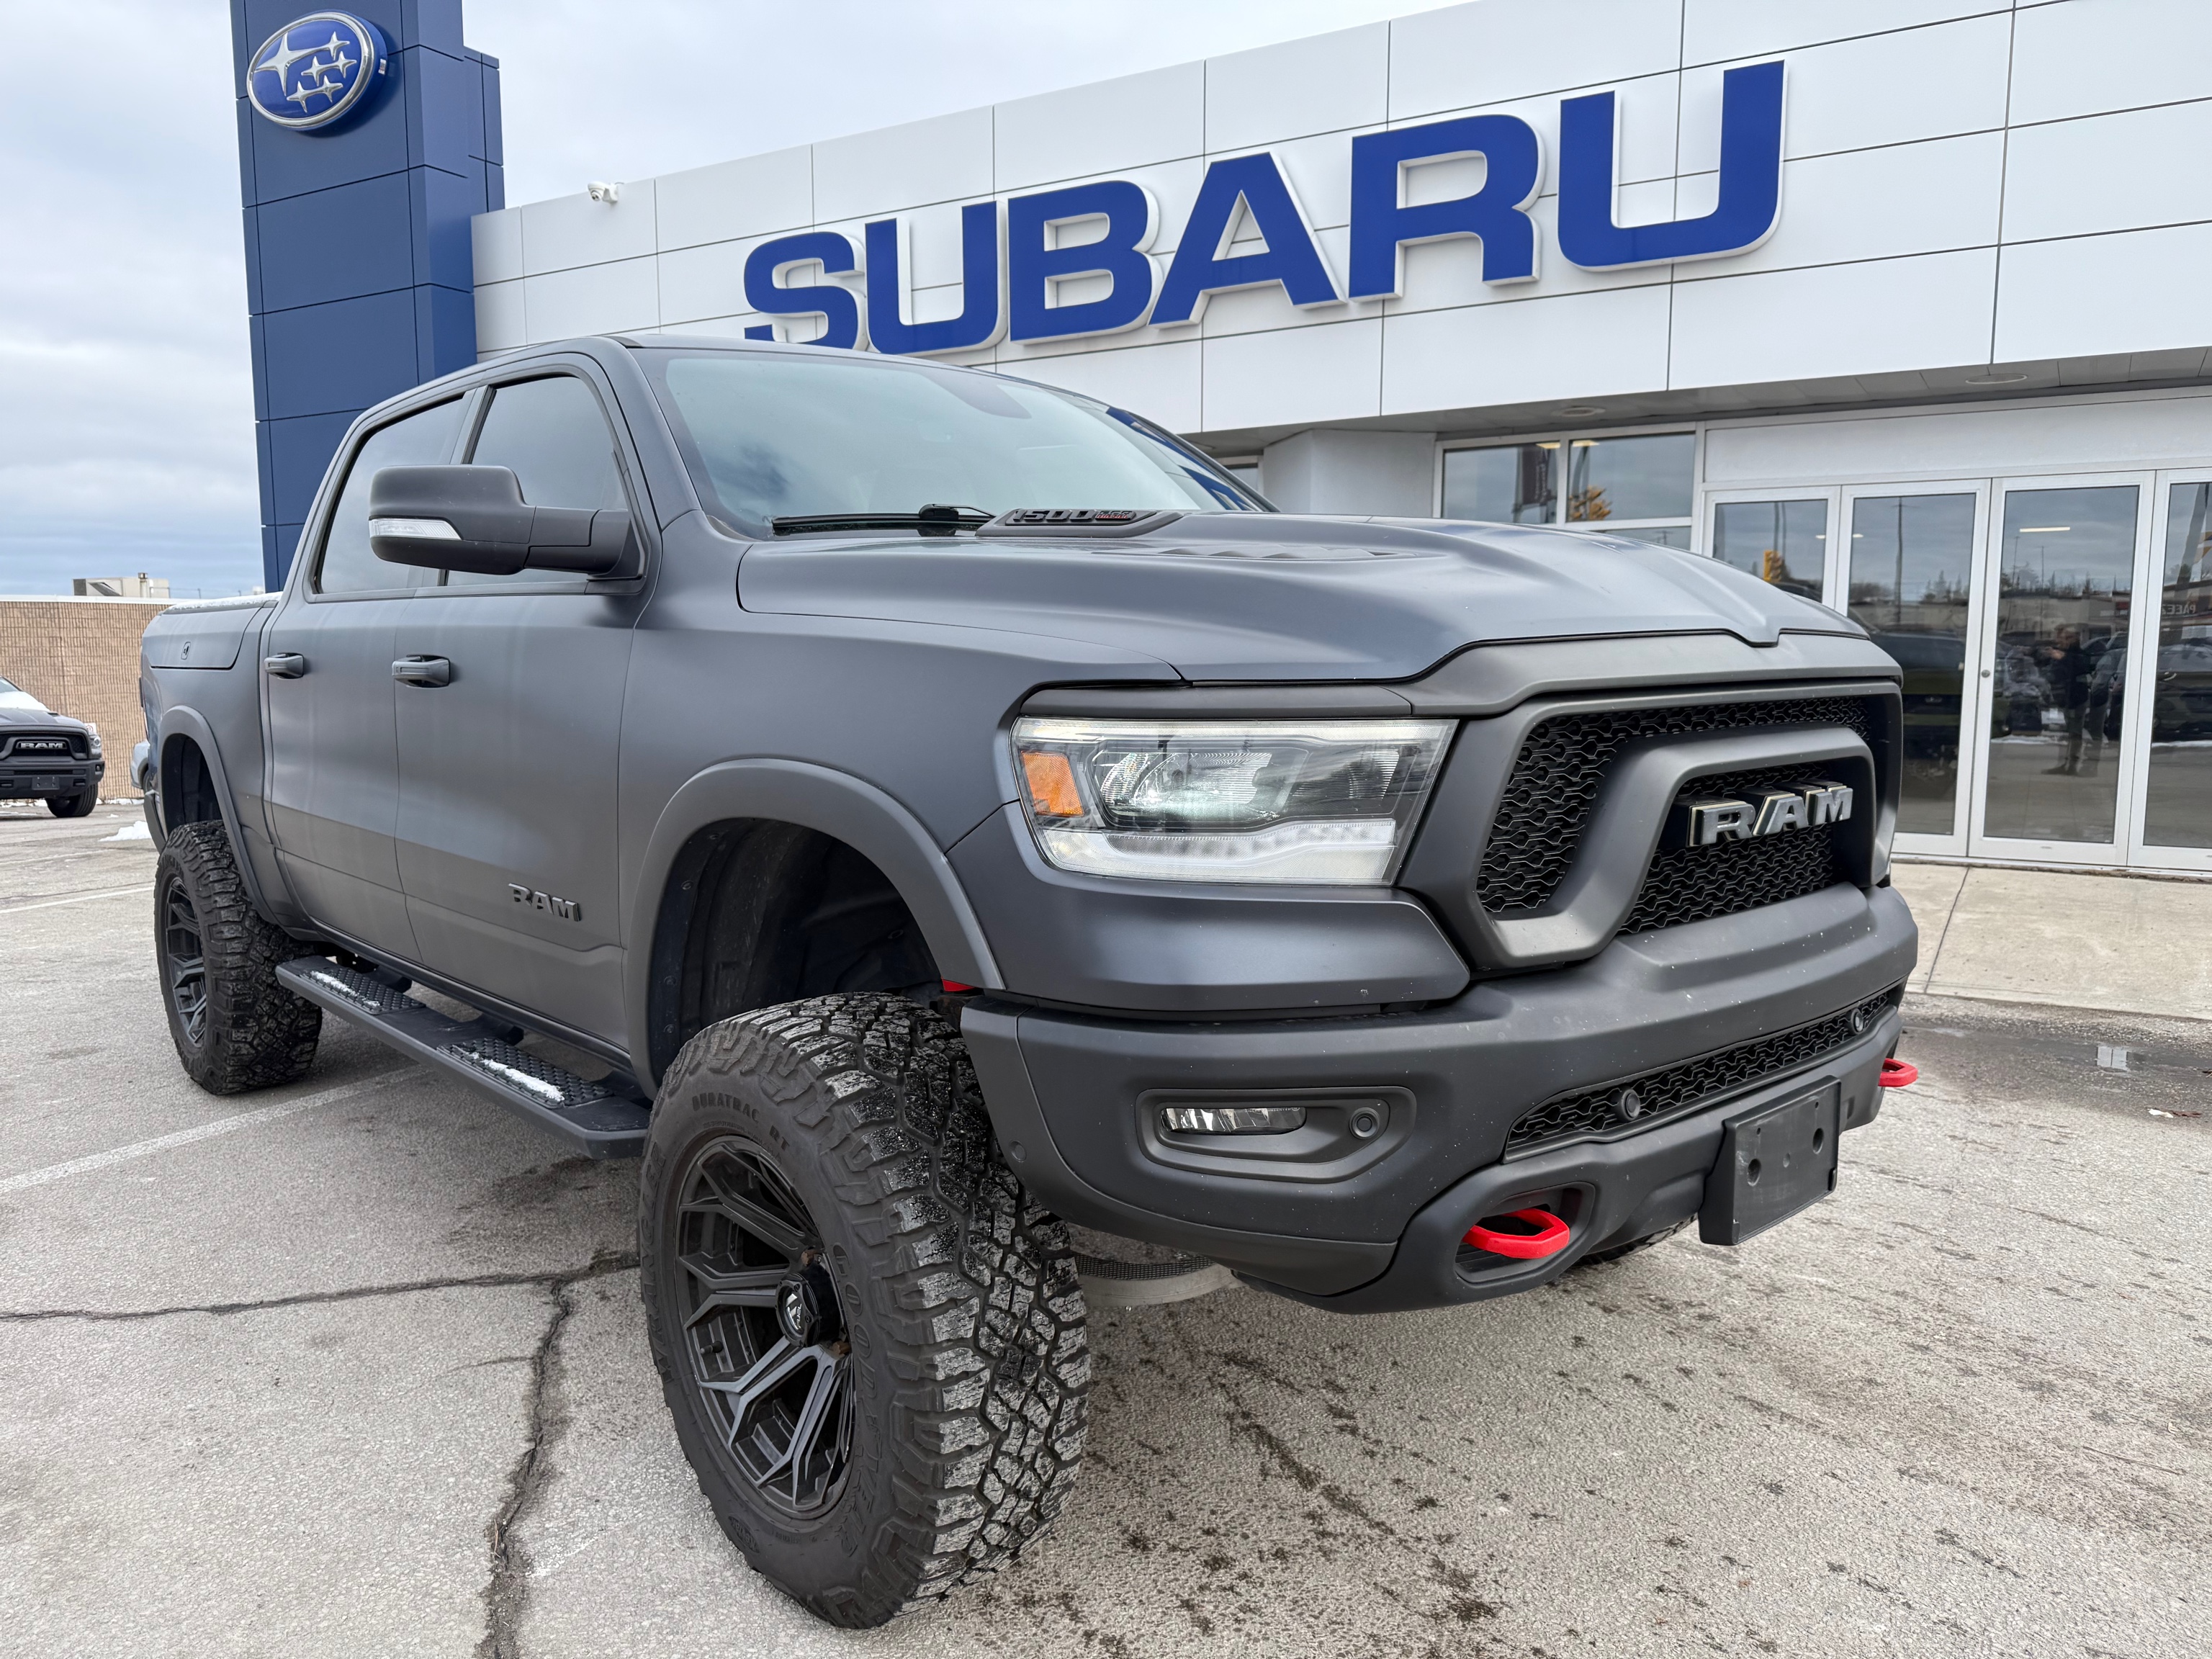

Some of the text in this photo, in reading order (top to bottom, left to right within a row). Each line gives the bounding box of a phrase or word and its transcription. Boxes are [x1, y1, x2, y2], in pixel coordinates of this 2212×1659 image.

[744, 60, 1786, 355] SUBARU
[1012, 509, 1096, 522] 1500
[1689, 786, 1853, 847] RAM
[508, 883, 581, 922] RAM
[692, 1092, 760, 1124] DURATRAC
[769, 1125, 791, 1151] RT
